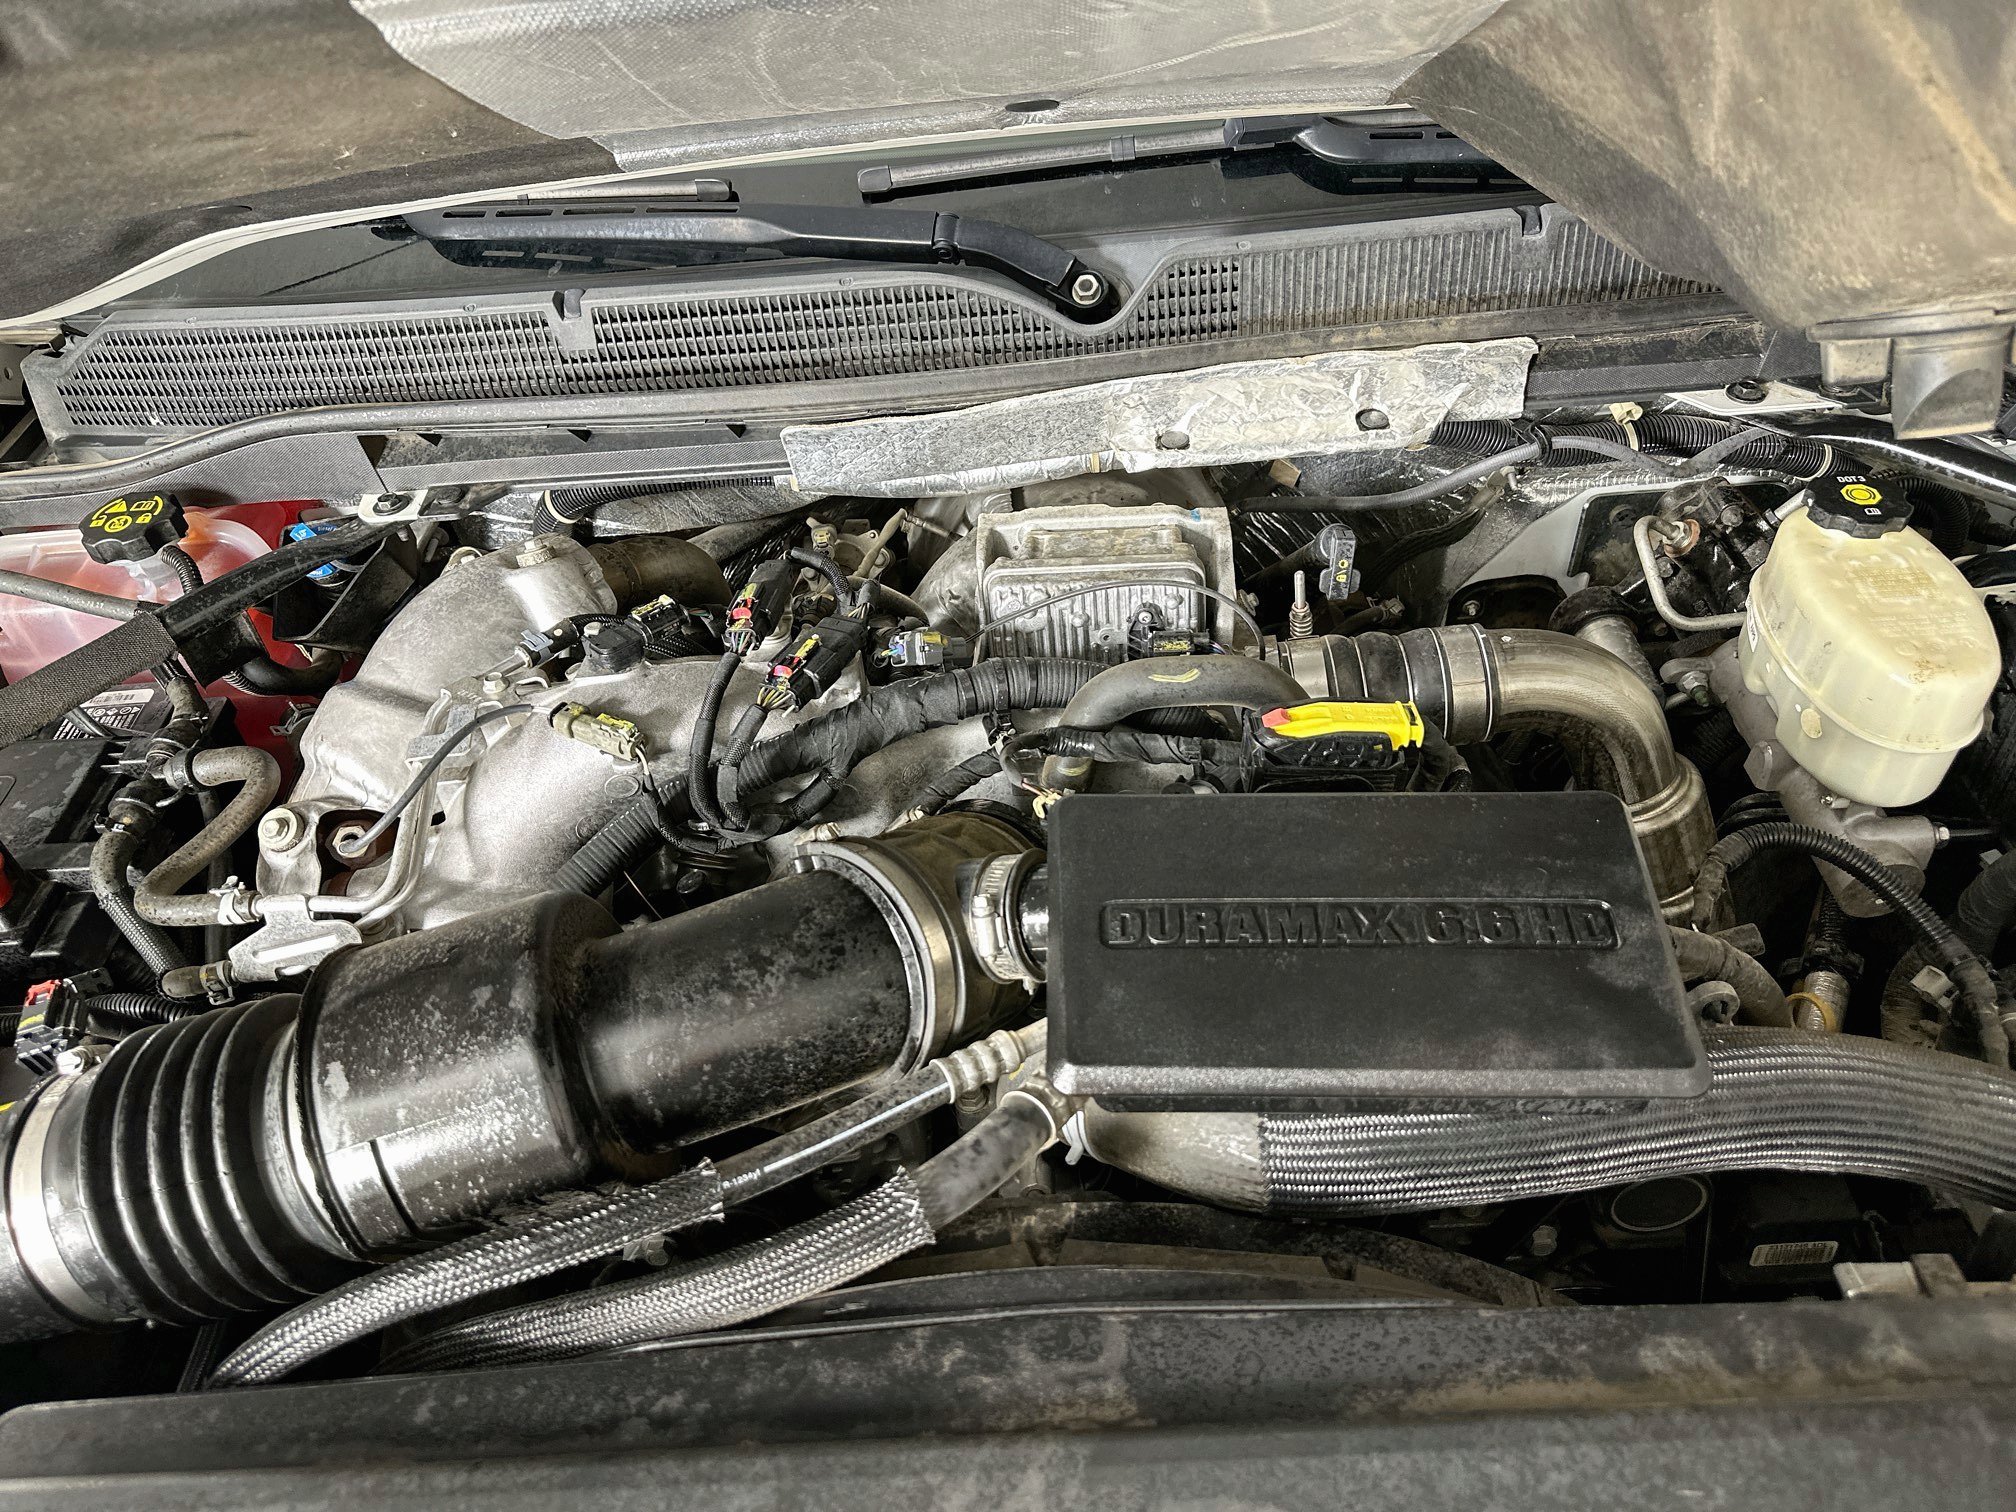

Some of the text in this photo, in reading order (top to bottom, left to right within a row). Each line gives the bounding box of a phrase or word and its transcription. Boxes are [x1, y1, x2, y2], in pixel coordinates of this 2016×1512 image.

[1106, 902, 1615, 945] DURAMAX 6.6 HD
